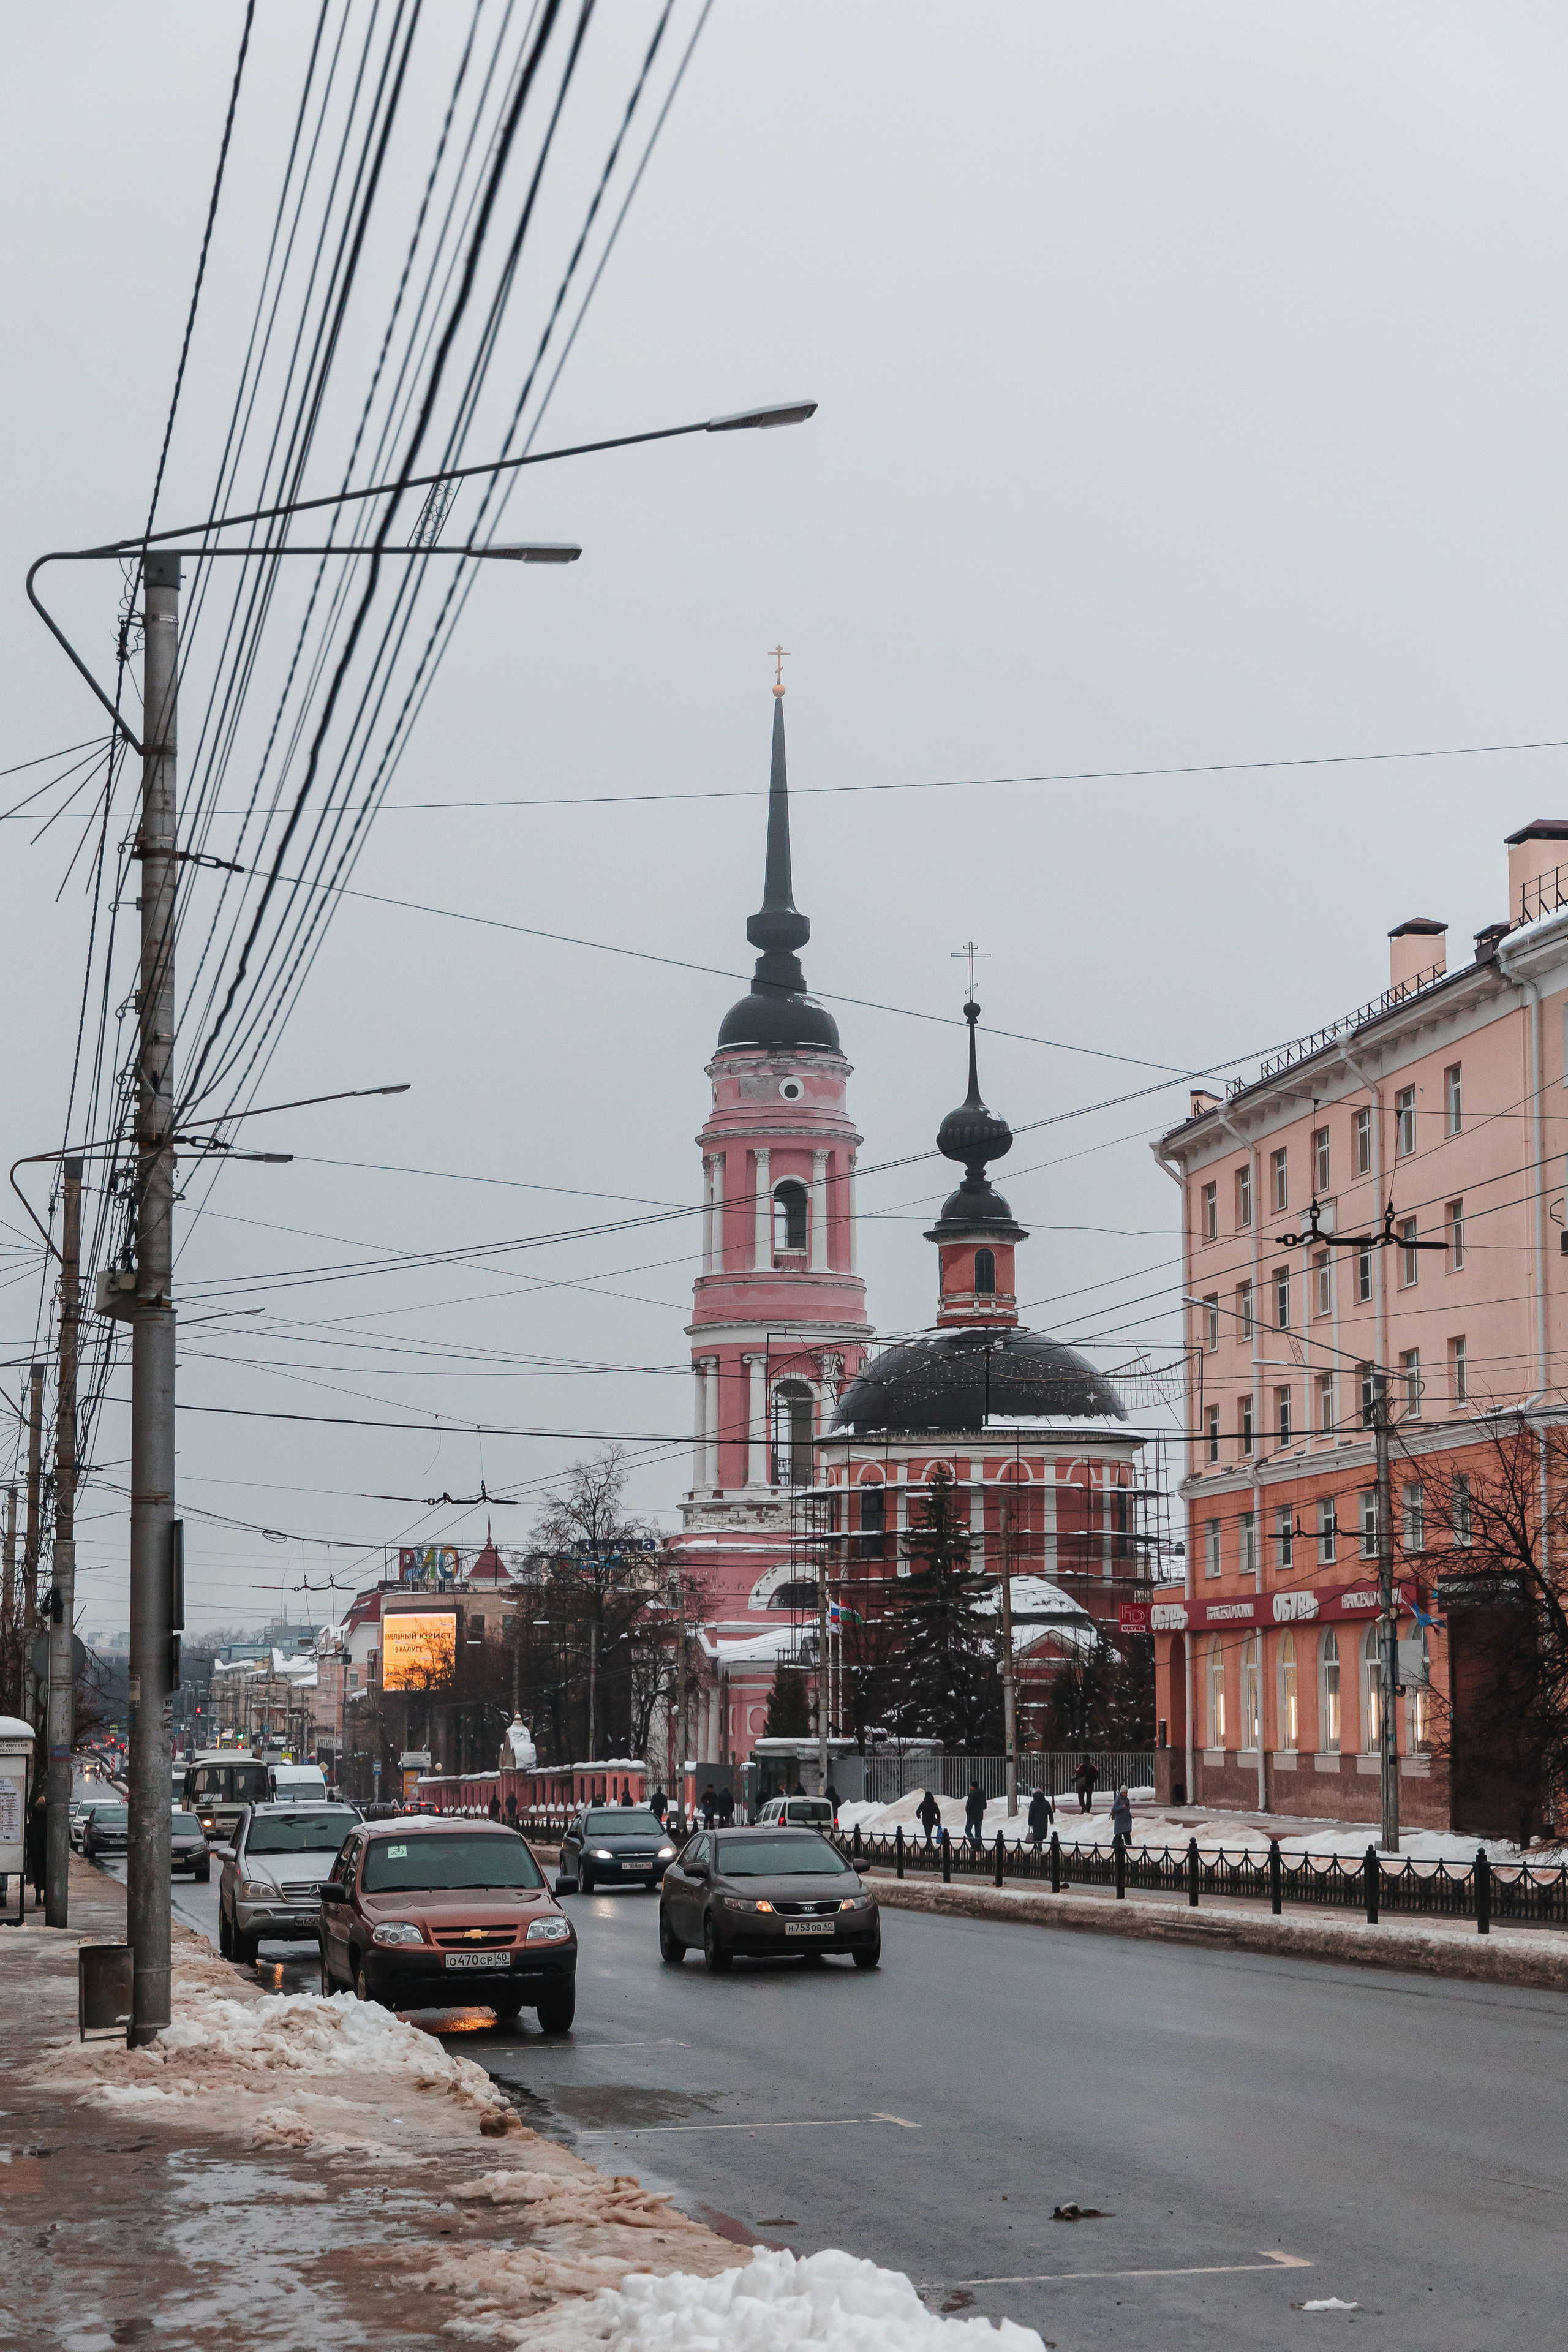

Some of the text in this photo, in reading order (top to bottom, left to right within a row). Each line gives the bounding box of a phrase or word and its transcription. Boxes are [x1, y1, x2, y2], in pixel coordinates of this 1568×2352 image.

[1151, 1604, 1188, 1630] ОБУВЬ
[1273, 1591, 1319, 1622] ОБУВЬ
[497, 1953, 507, 1961] 40
